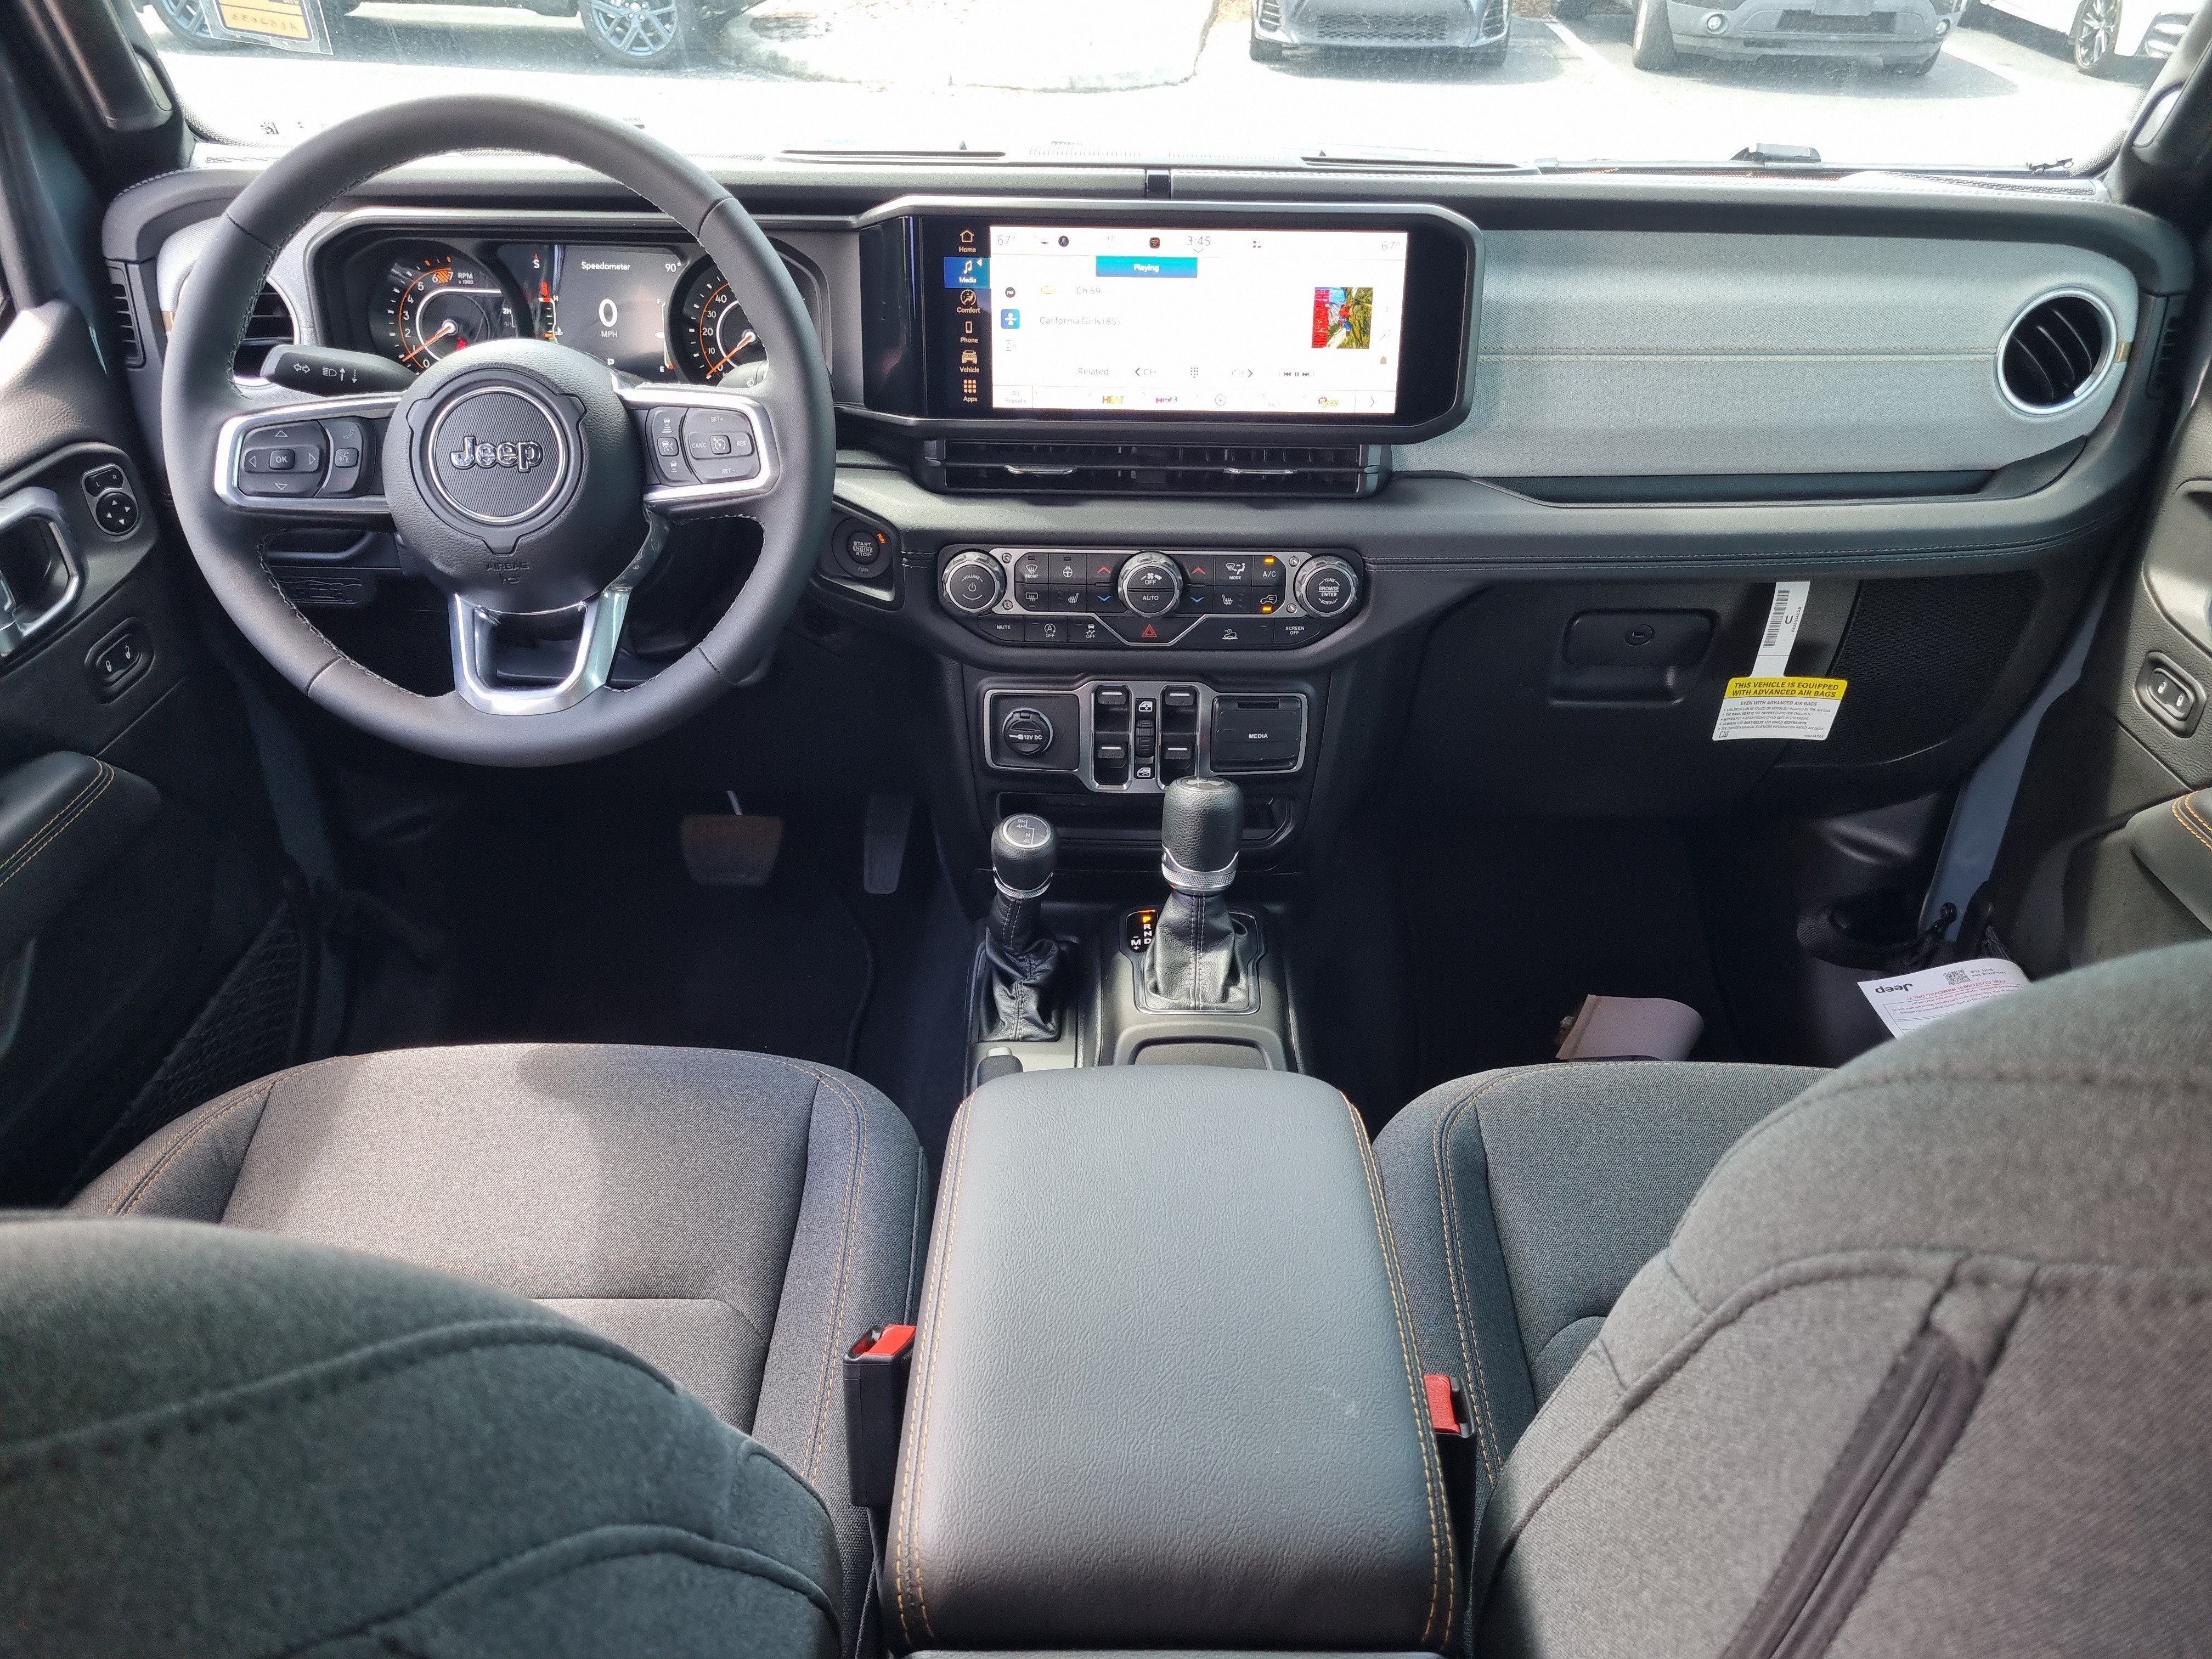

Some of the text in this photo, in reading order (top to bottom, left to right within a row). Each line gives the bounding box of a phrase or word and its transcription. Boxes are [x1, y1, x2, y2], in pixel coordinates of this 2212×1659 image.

[1187, 236, 1211, 246] 3:45
[534, 260, 540, 268] S
[581, 262, 631, 271] Speedometer
[1133, 263, 1160, 273] Playing
[432, 272, 453, 283] 6 7
[417, 282, 424, 291] 5
[407, 295, 414, 303] 4
[715, 295, 727, 303] 40
[403, 311, 410, 320] 3
[598, 298, 618, 327] 0
[1103, 318, 1120, 326] (85)
[404, 329, 411, 338] 2
[702, 328, 714, 336] 20
[423, 359, 430, 368] 0
[1102, 396, 1125, 404] HEAT
[450, 435, 544, 473] Jeep
[1785, 615, 1793, 624] U
[1797, 682, 1839, 691] EQUIPPED
[1875, 983, 1914, 994] Jeep
[1957, 980, 1991, 990] CUSTOMER
[1926, 987, 1956, 997] REMOVAL
